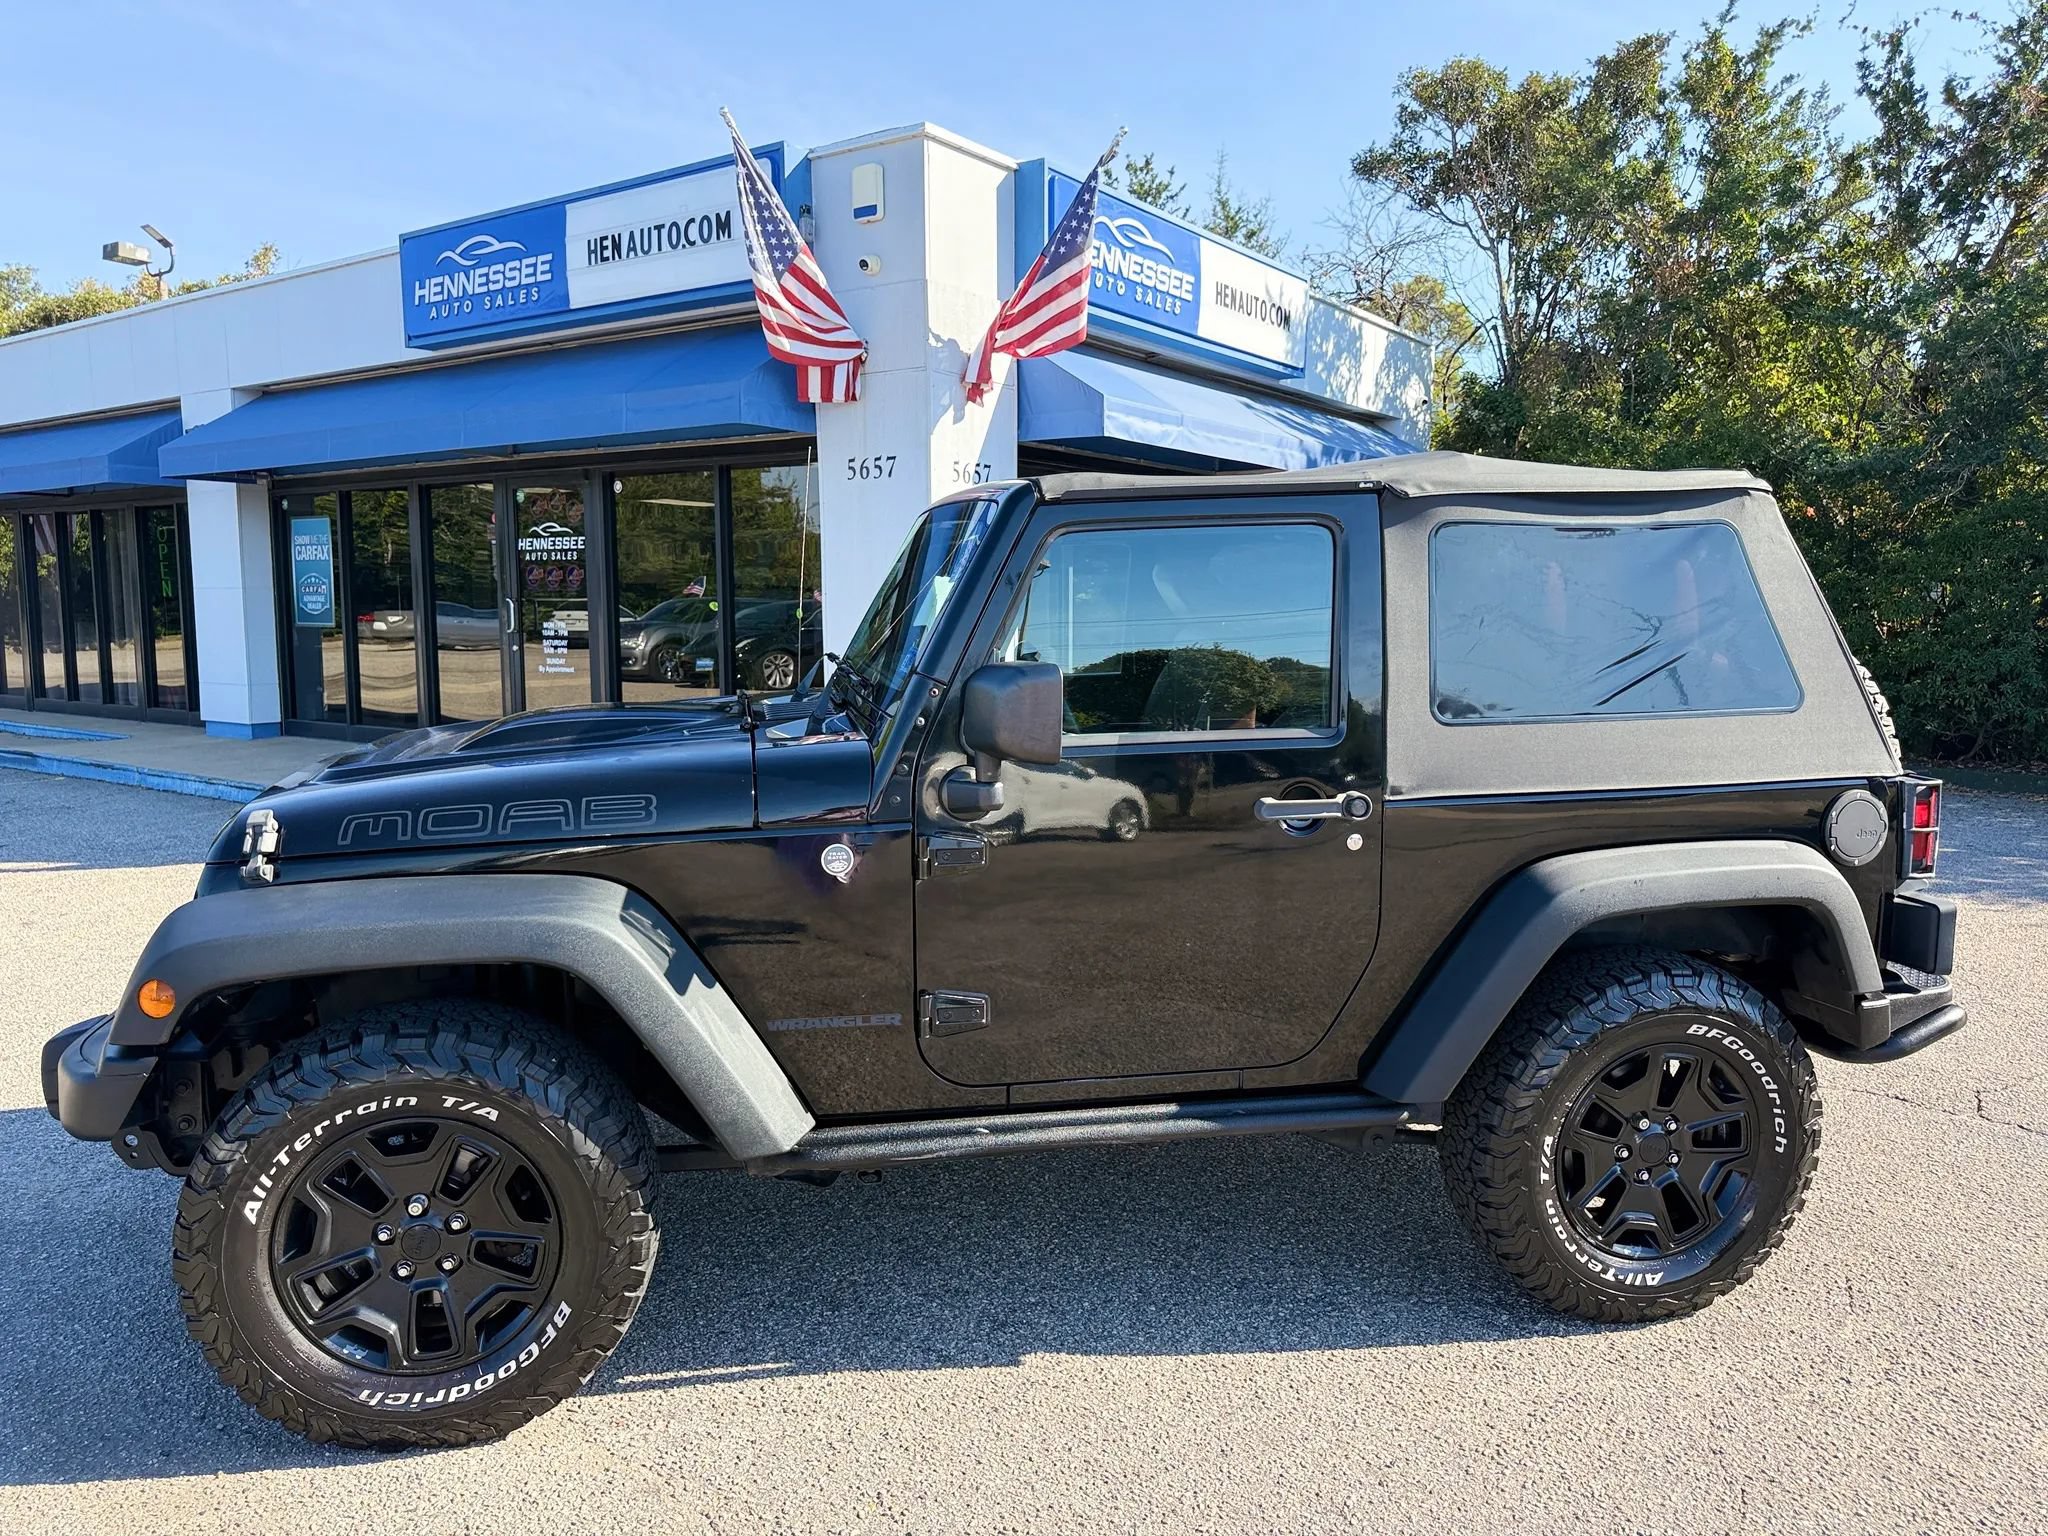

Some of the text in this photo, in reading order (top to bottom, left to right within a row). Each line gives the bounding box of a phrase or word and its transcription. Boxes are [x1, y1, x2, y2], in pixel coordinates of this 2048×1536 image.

[587, 210, 733, 266] HENAUTO.COM
[414, 253, 553, 306] HENNESSEE
[1090, 240, 1195, 302] ENNESSEE
[1094, 271, 1182, 315] UTO SALES
[429, 287, 540, 319] AUTO SALES
[847, 455, 897, 480] 5657
[952, 461, 992, 485] 5657
[157, 526, 172, 597] OPEN
[295, 535, 310, 545] SHOW
[295, 545, 329, 560] CARFAX
[518, 536, 586, 550] HENNESSEE
[525, 551, 578, 561] AUTO SALES
[542, 639, 568, 647] SATURDAY
[337, 794, 657, 845] MOAB
[767, 1013, 902, 1031] WRANGLER
[1685, 1023, 1789, 1154] BFGoodrich
[243, 1095, 418, 1225] All-Terrain
[441, 1095, 500, 1122] T/A
[1540, 1135, 1664, 1286] All-Terrain T/A
[358, 1301, 573, 1409] BFGoodrich
